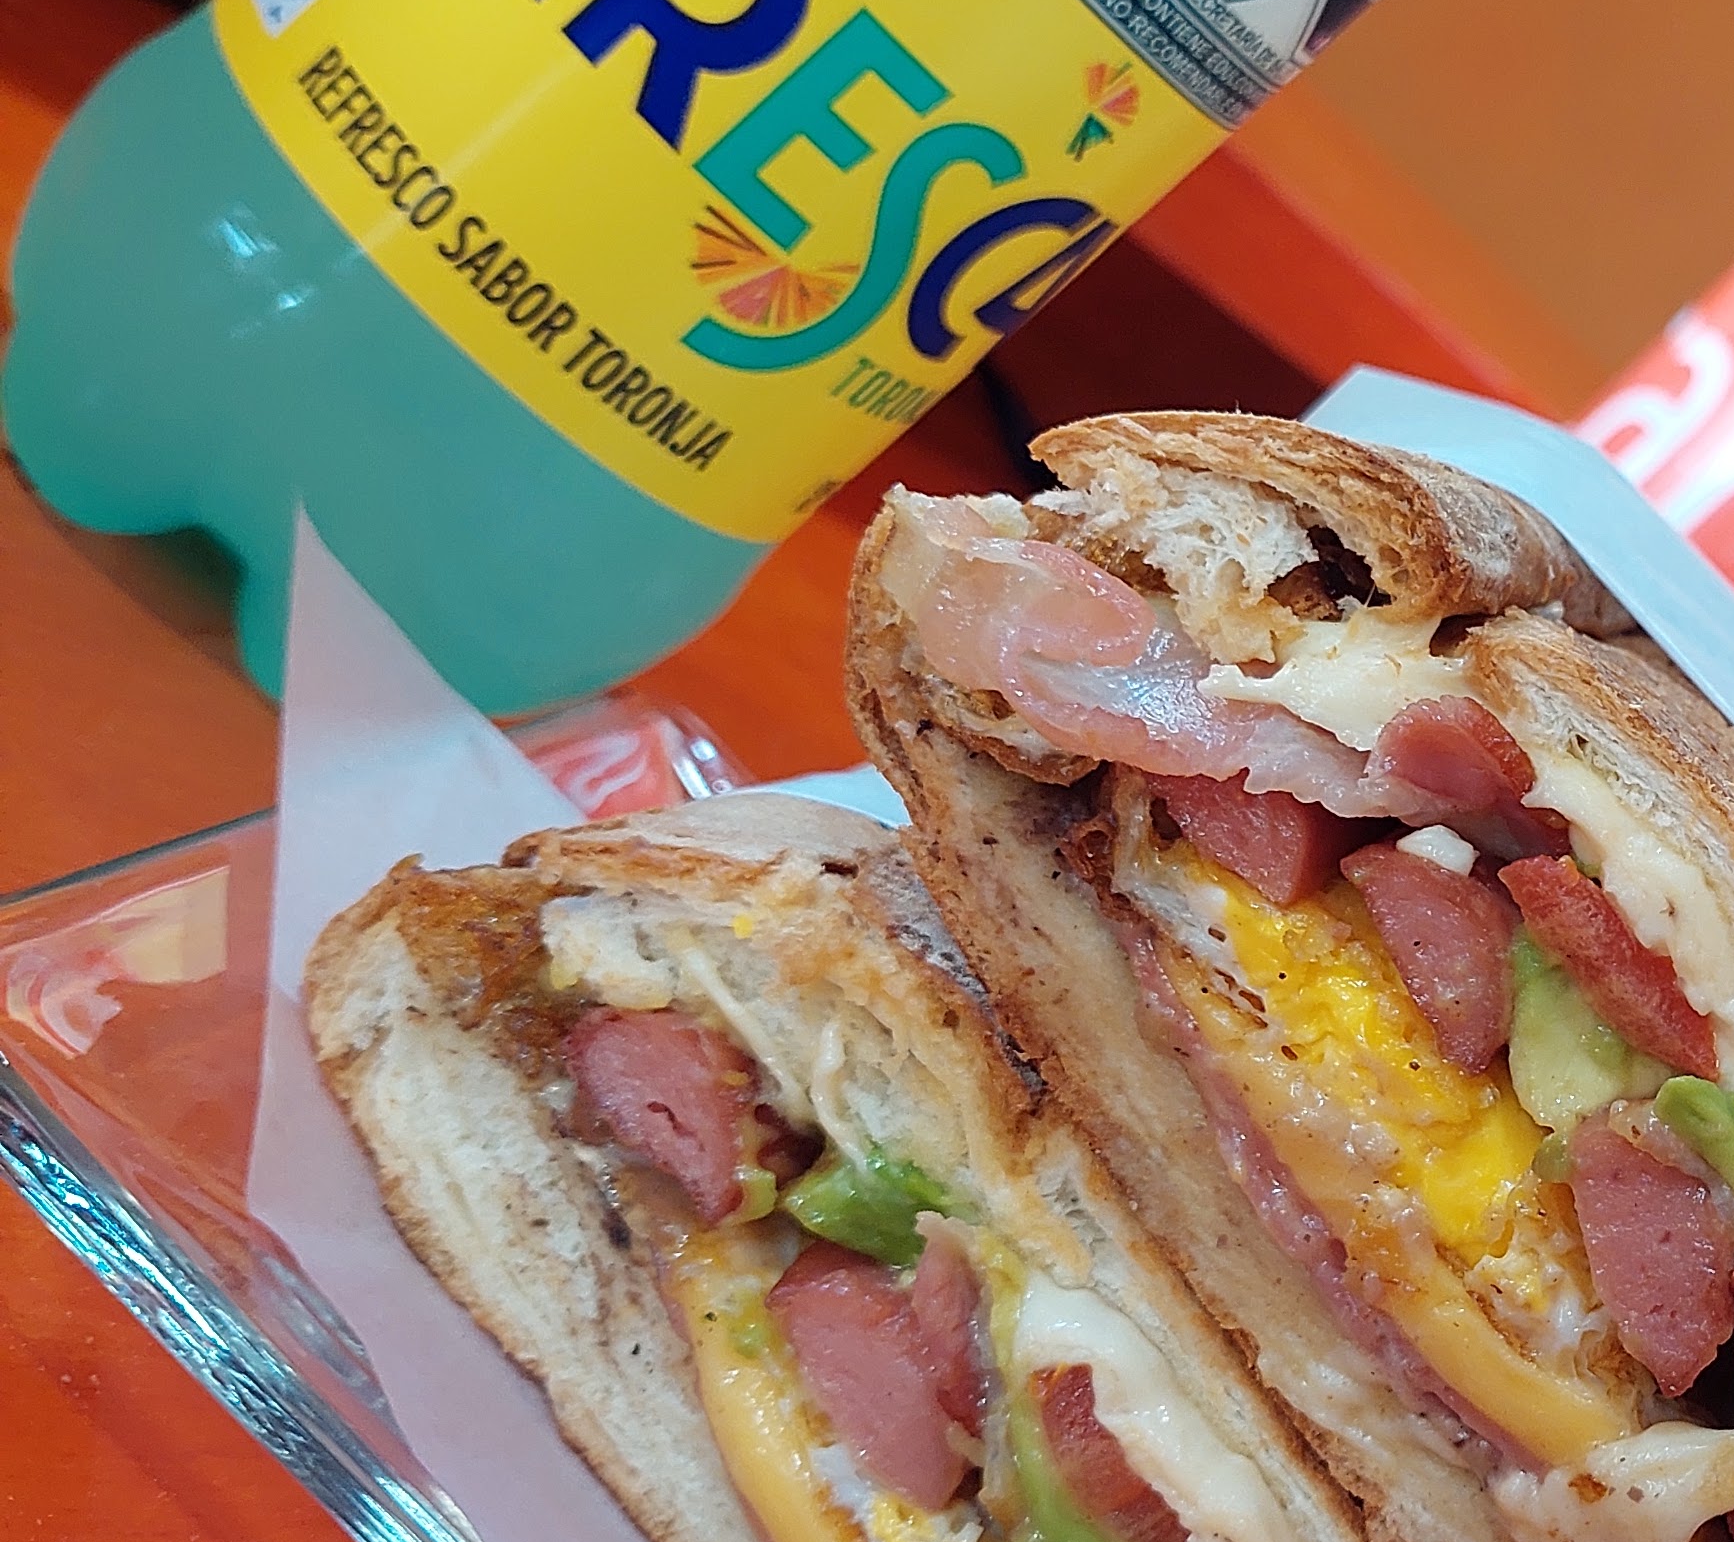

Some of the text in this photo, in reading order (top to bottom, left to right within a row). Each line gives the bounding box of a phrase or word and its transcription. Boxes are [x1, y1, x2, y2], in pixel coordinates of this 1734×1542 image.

[298, 46, 733, 472] REFRESCO SABOR TORONJA
